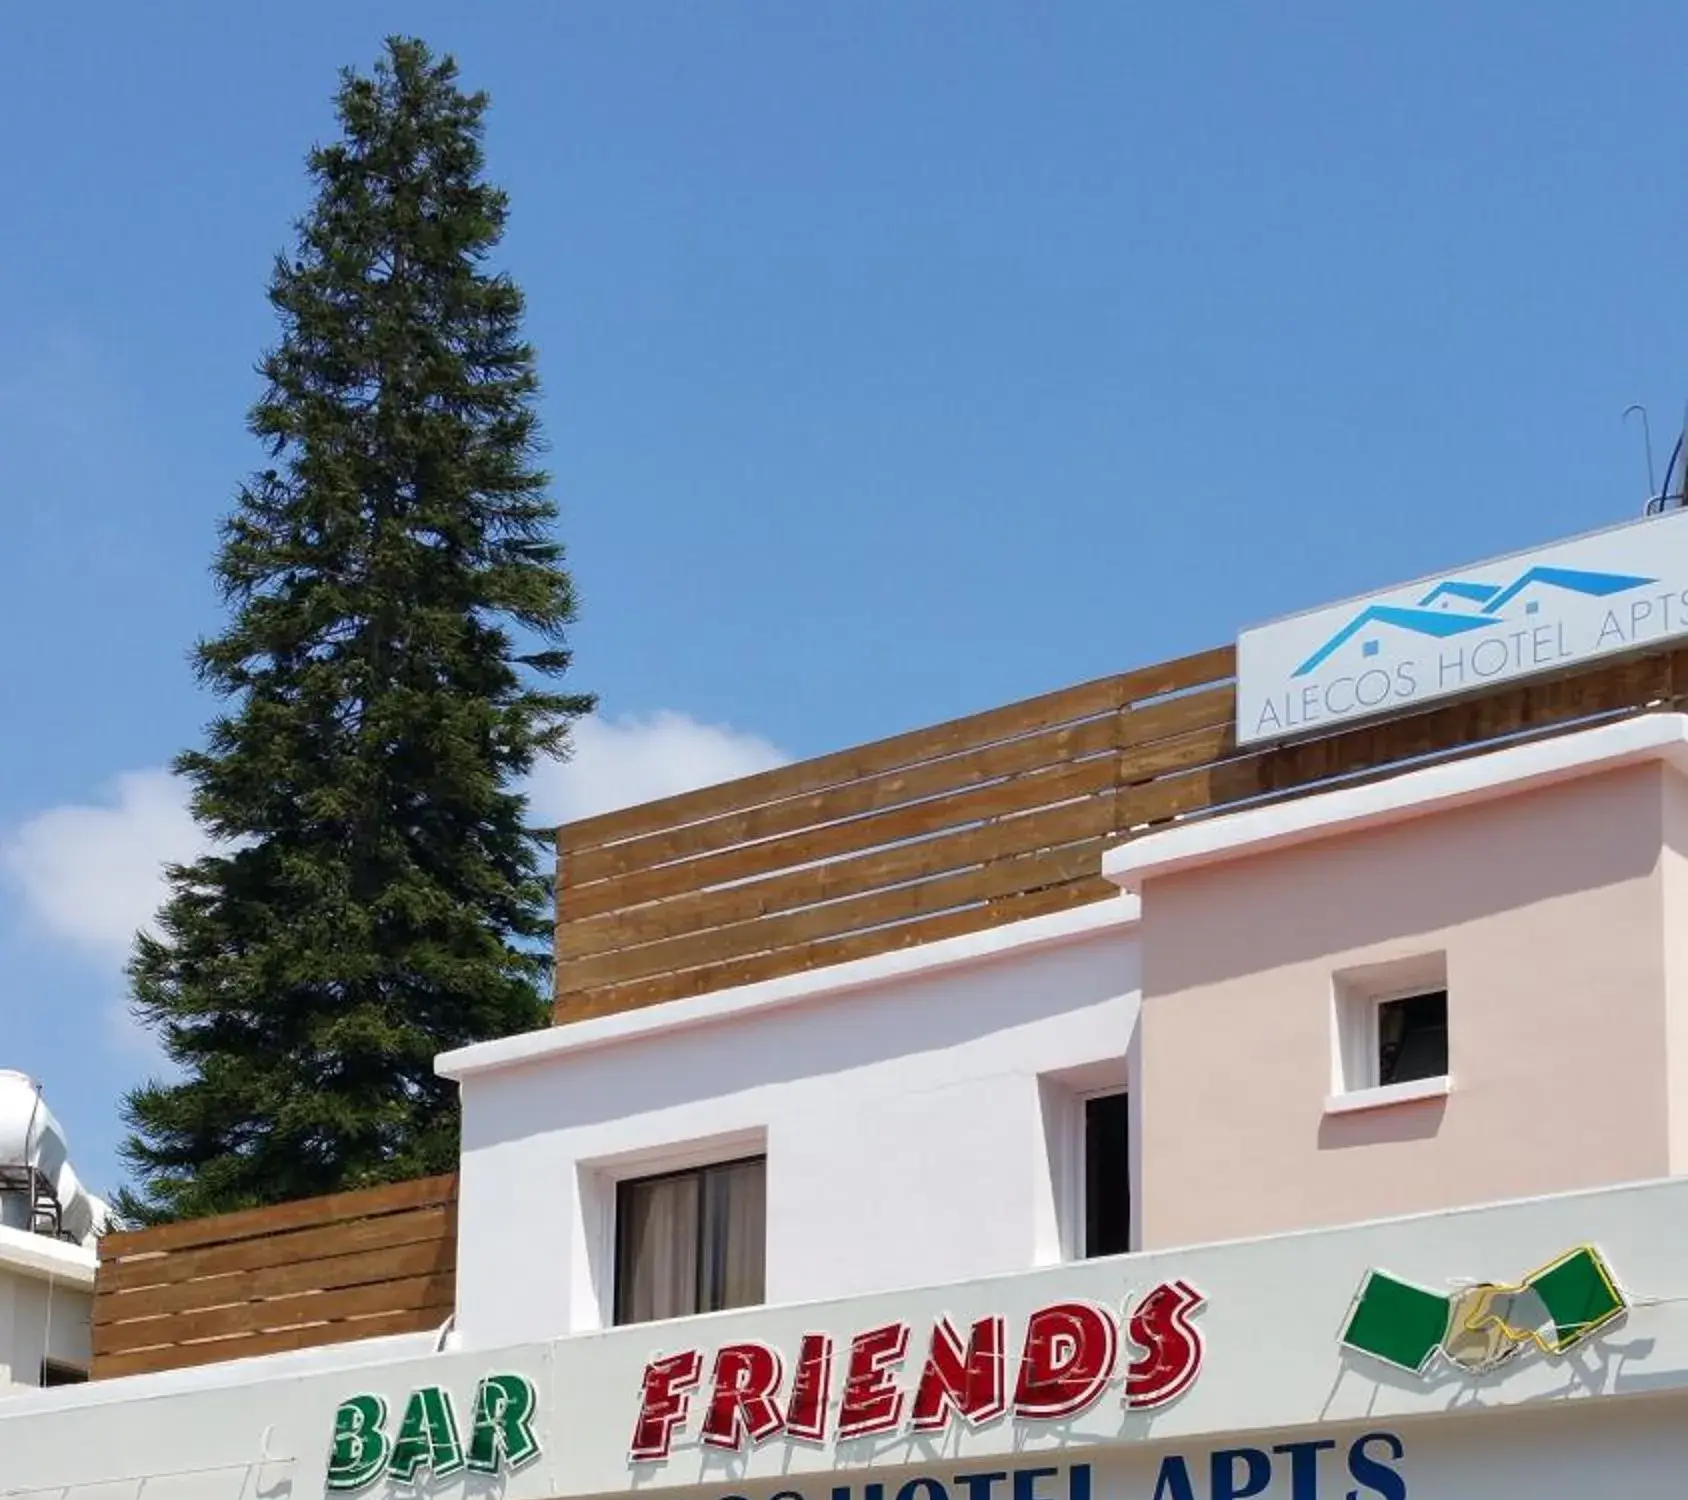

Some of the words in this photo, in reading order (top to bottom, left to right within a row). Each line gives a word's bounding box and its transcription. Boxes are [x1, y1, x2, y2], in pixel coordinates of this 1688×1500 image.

[1256, 661, 1416, 734] ALECOS
[1438, 620, 1572, 689] HOTEL
[629, 1277, 1208, 1464] FRIENDS
[326, 1371, 543, 1492] BAR
